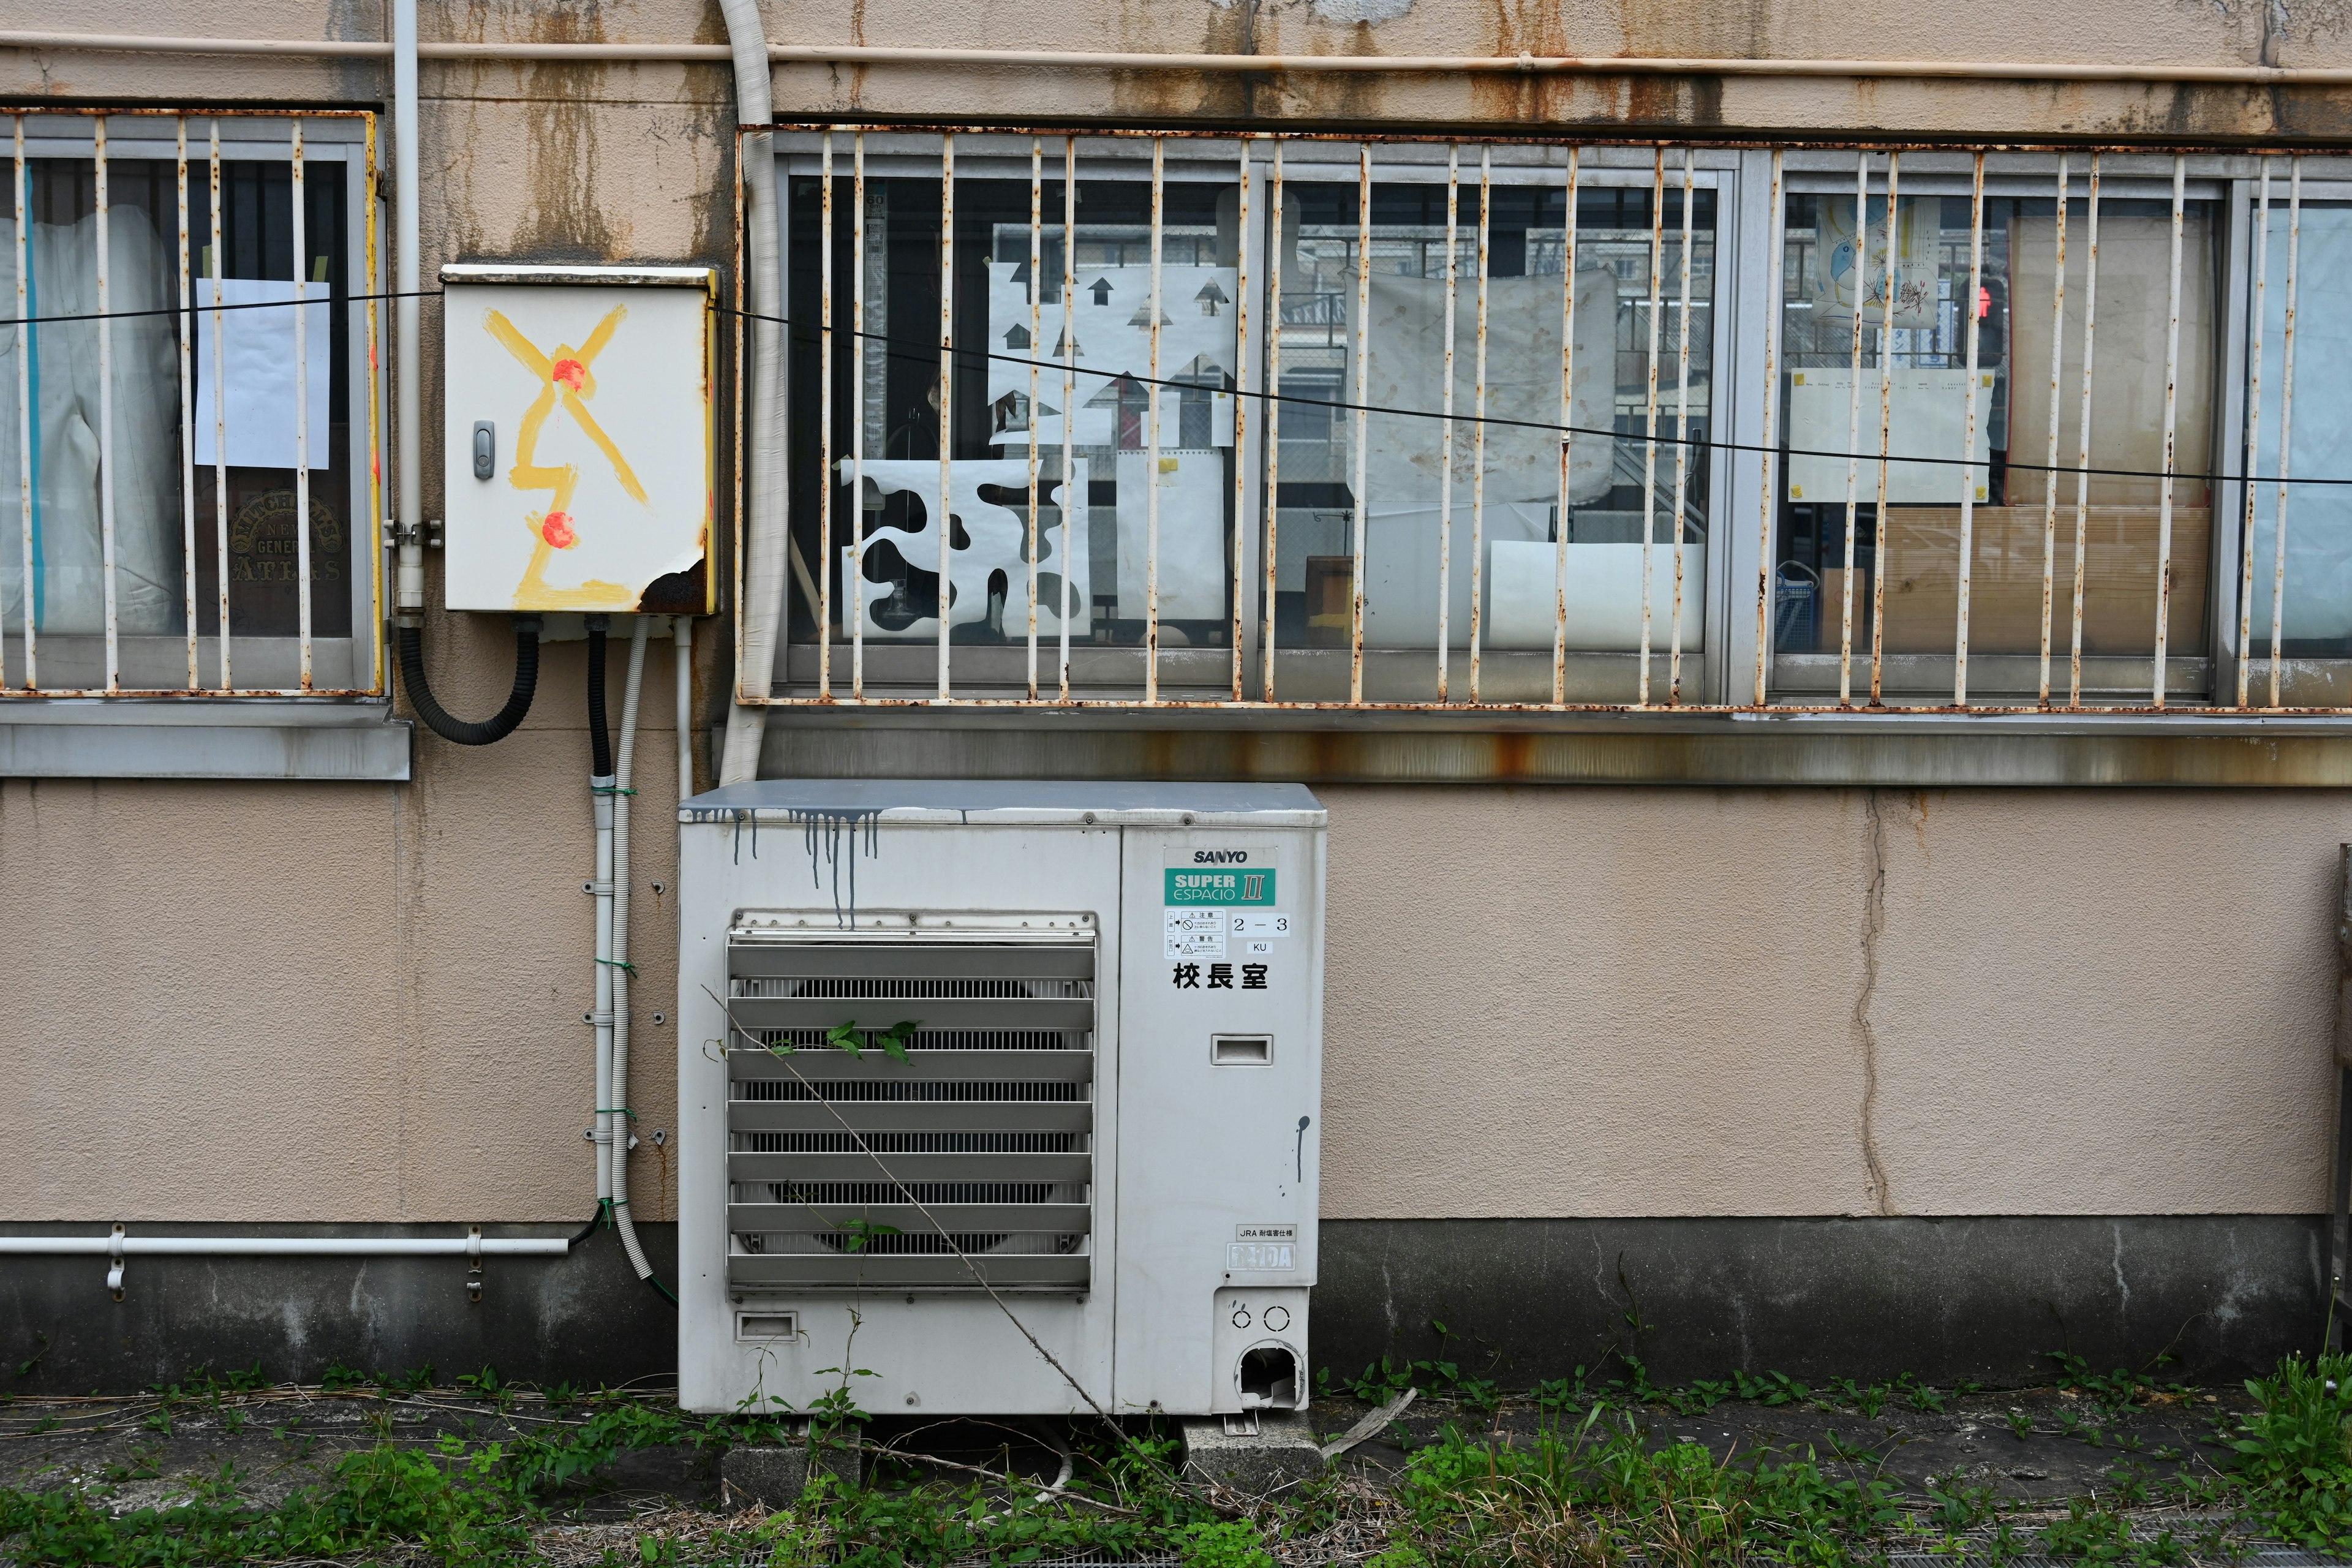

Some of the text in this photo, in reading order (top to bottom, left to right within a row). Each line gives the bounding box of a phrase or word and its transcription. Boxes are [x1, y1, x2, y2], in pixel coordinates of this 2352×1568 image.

[866, 195, 884, 205] 60
[258, 541, 315, 554] GENERL
[1194, 849, 1247, 865] SANYO
[1175, 875, 1235, 888] SUPER
[1174, 889, 1235, 900] ESPACIO
[1173, 962, 1268, 989] 校長室
